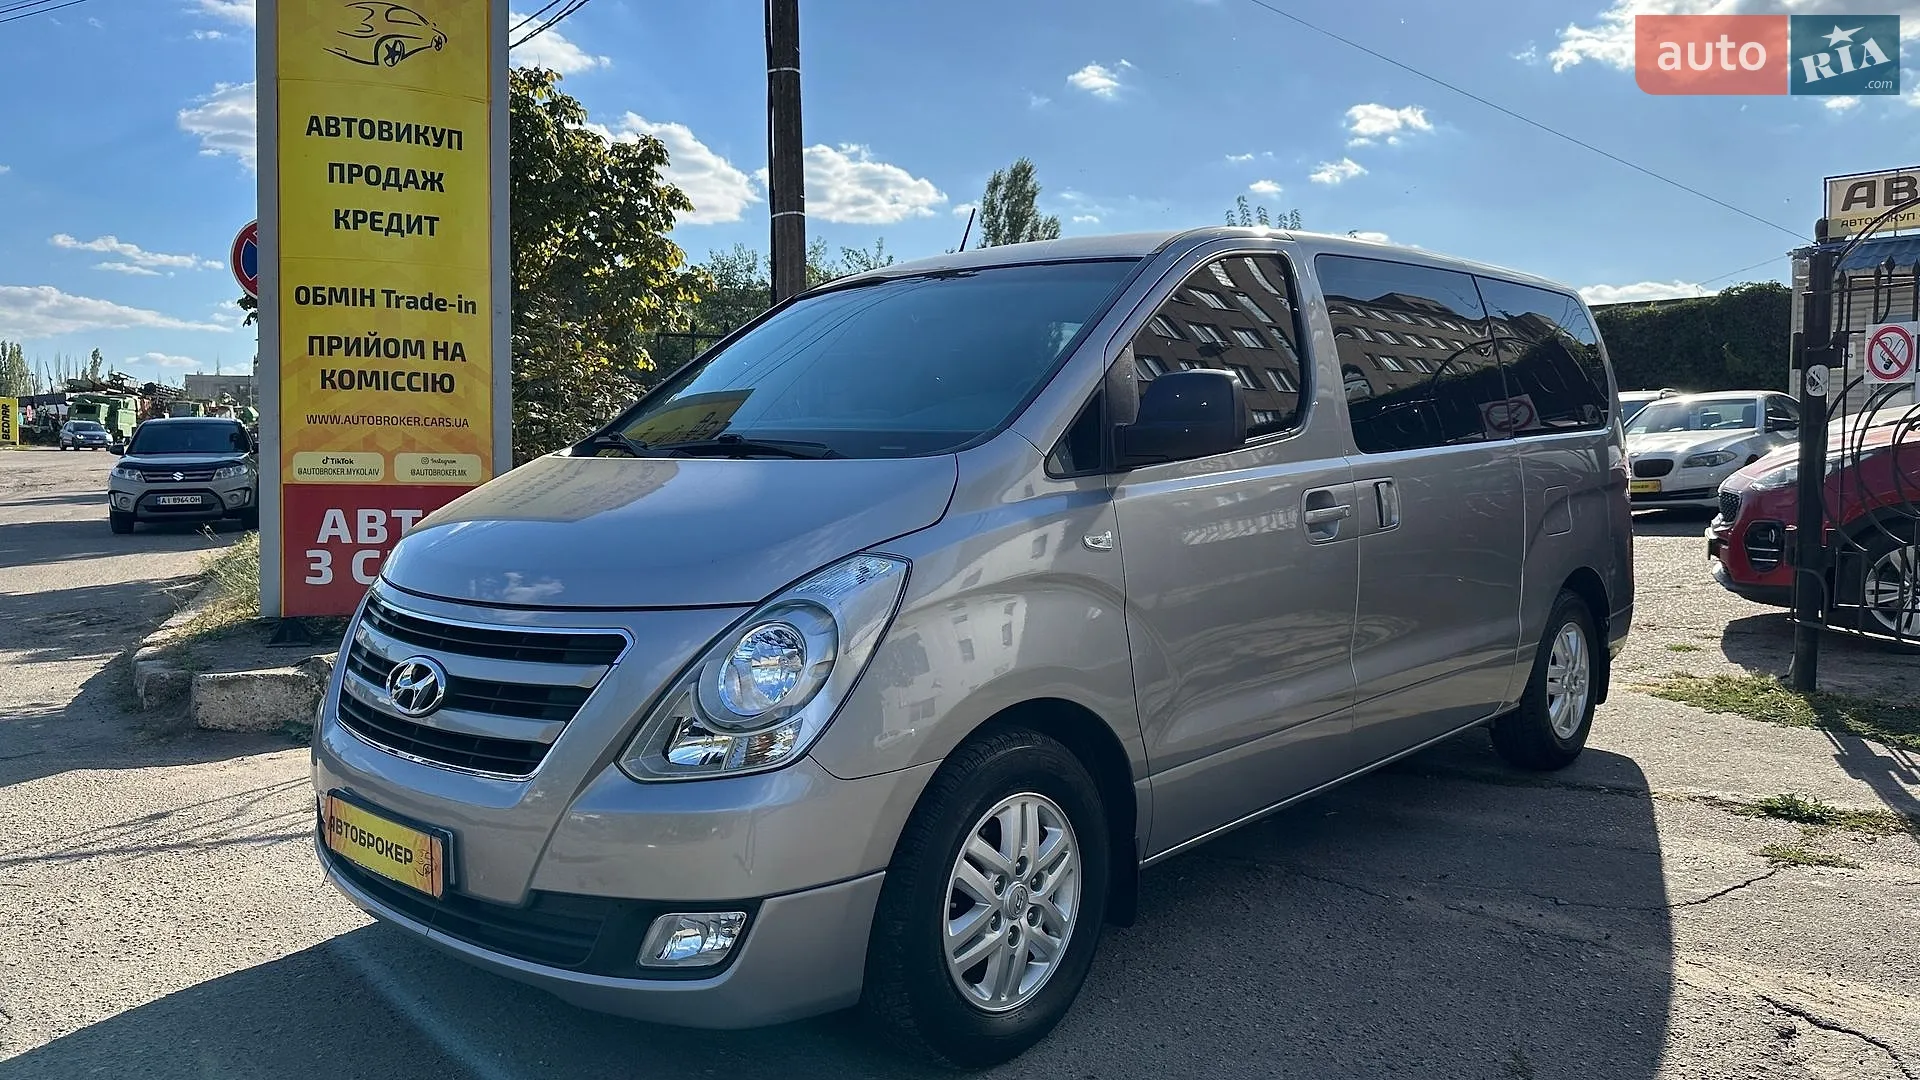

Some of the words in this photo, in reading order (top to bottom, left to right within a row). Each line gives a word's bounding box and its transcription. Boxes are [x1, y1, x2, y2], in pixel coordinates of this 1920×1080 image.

[305, 115, 463, 151] АВТОВИКУП
[328, 162, 445, 193] ПРОДАЖ
[334, 208, 440, 237] КРЕДИТ
[294, 285, 376, 308] ОБМІН
[381, 289, 477, 315] Trade-in
[308, 331, 426, 360] ПРИЙОМ
[432, 341, 467, 362] НА
[320, 368, 456, 394] КОМІССІЮ
[306, 414, 470, 428] WWW.AUTOBROKER.CARS.UA
[297, 467, 380, 476] @AUTOBROKER.MYKOLAIV
[430, 457, 457, 465] Instagram
[316, 508, 432, 544] АВТ
[351, 550, 393, 585] С
[328, 815, 414, 865] АВТОБРОКЕР
